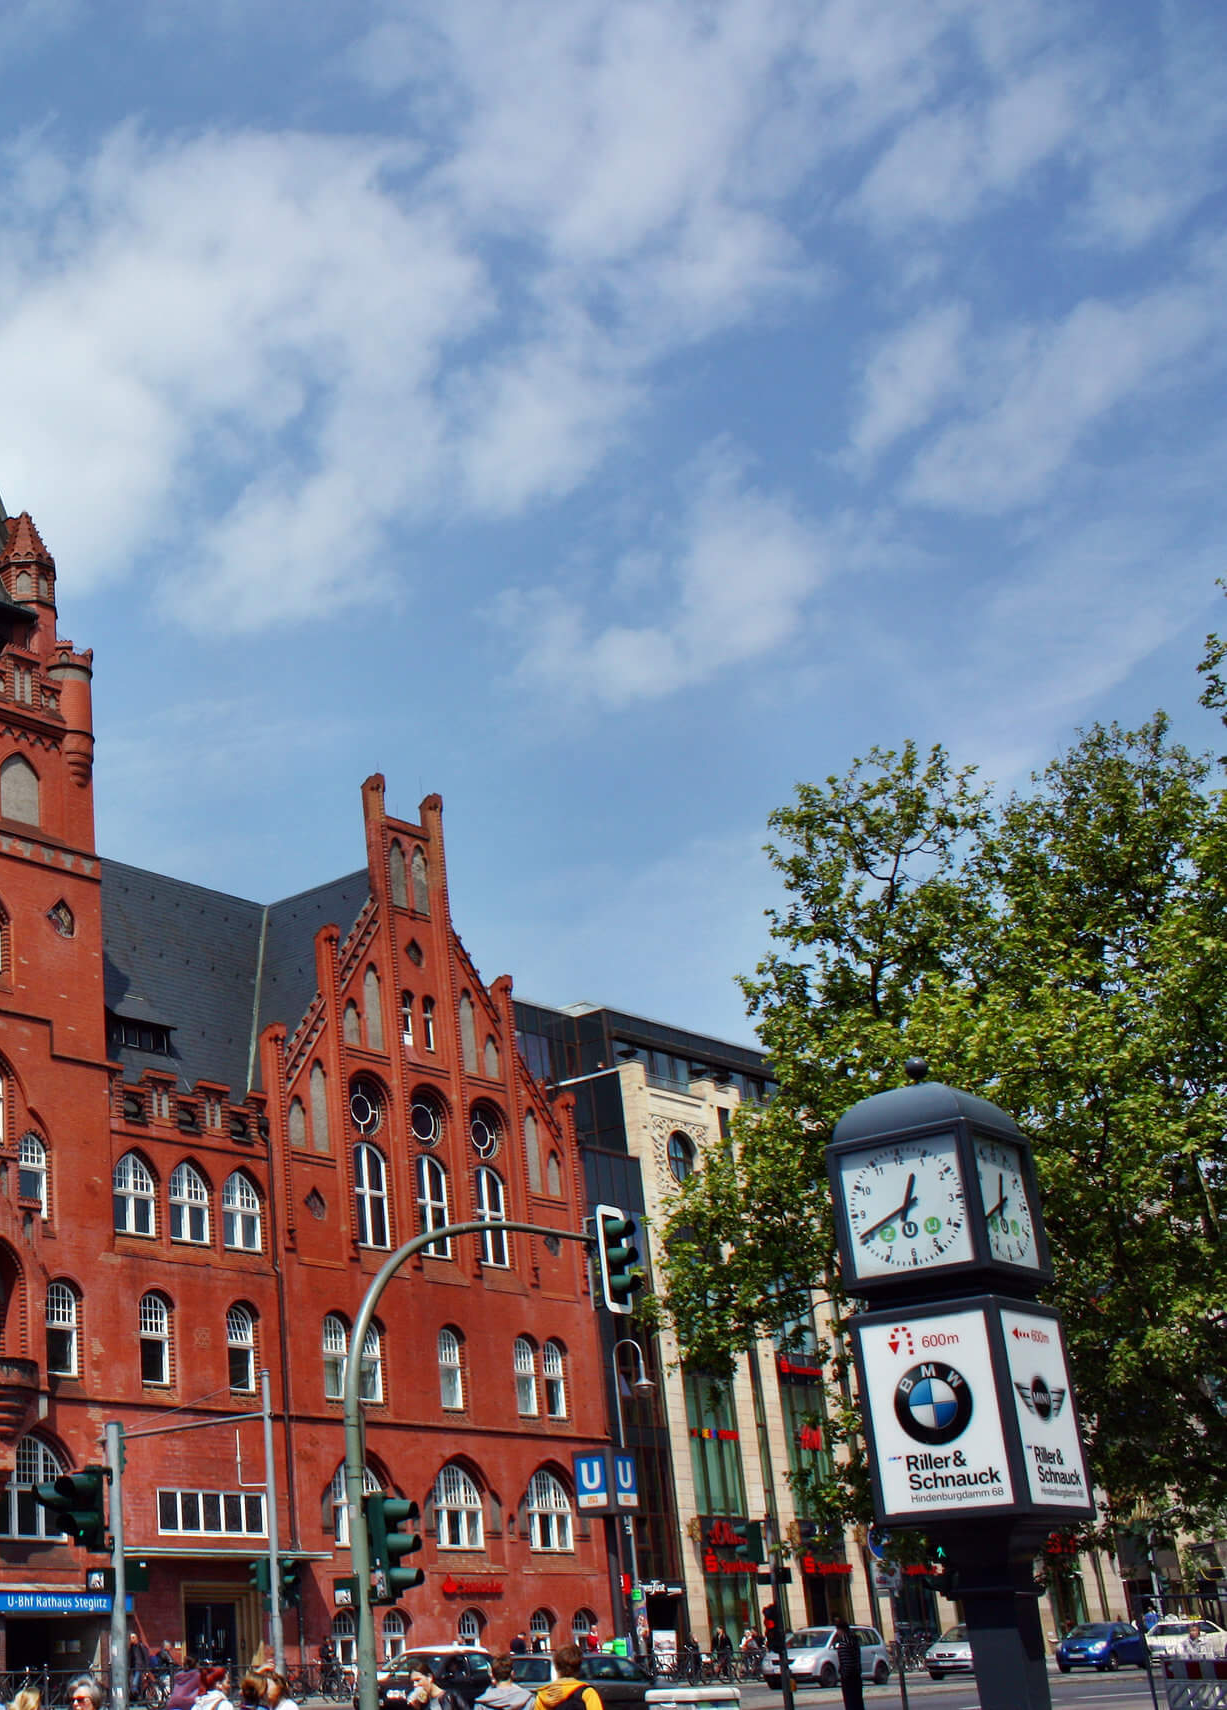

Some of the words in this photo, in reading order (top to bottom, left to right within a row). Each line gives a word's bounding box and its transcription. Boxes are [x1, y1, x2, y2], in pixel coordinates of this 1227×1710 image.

[894, 1155, 905, 1166] 12
[875, 1167, 884, 1176] 11
[938, 1171, 946, 1181] 2
[861, 1186, 871, 1196] 10
[948, 1193, 955, 1202] 3
[860, 1210, 867, 1219] 9
[921, 1333, 959, 1348] 600m
[580, 1460, 601, 1490] U
[617, 1460, 633, 1489] U
[909, 1466, 1002, 1491] Schnauck
[1037, 1465, 1082, 1486] Schnauck
[911, 1490, 990, 1503] Hindenburgdamm
[991, 1486, 1005, 1497] 68
[7, 1595, 34, 1608] U-Bhf
[36, 1596, 72, 1609] Rathaus
[74, 1597, 108, 1611] Steglitz
